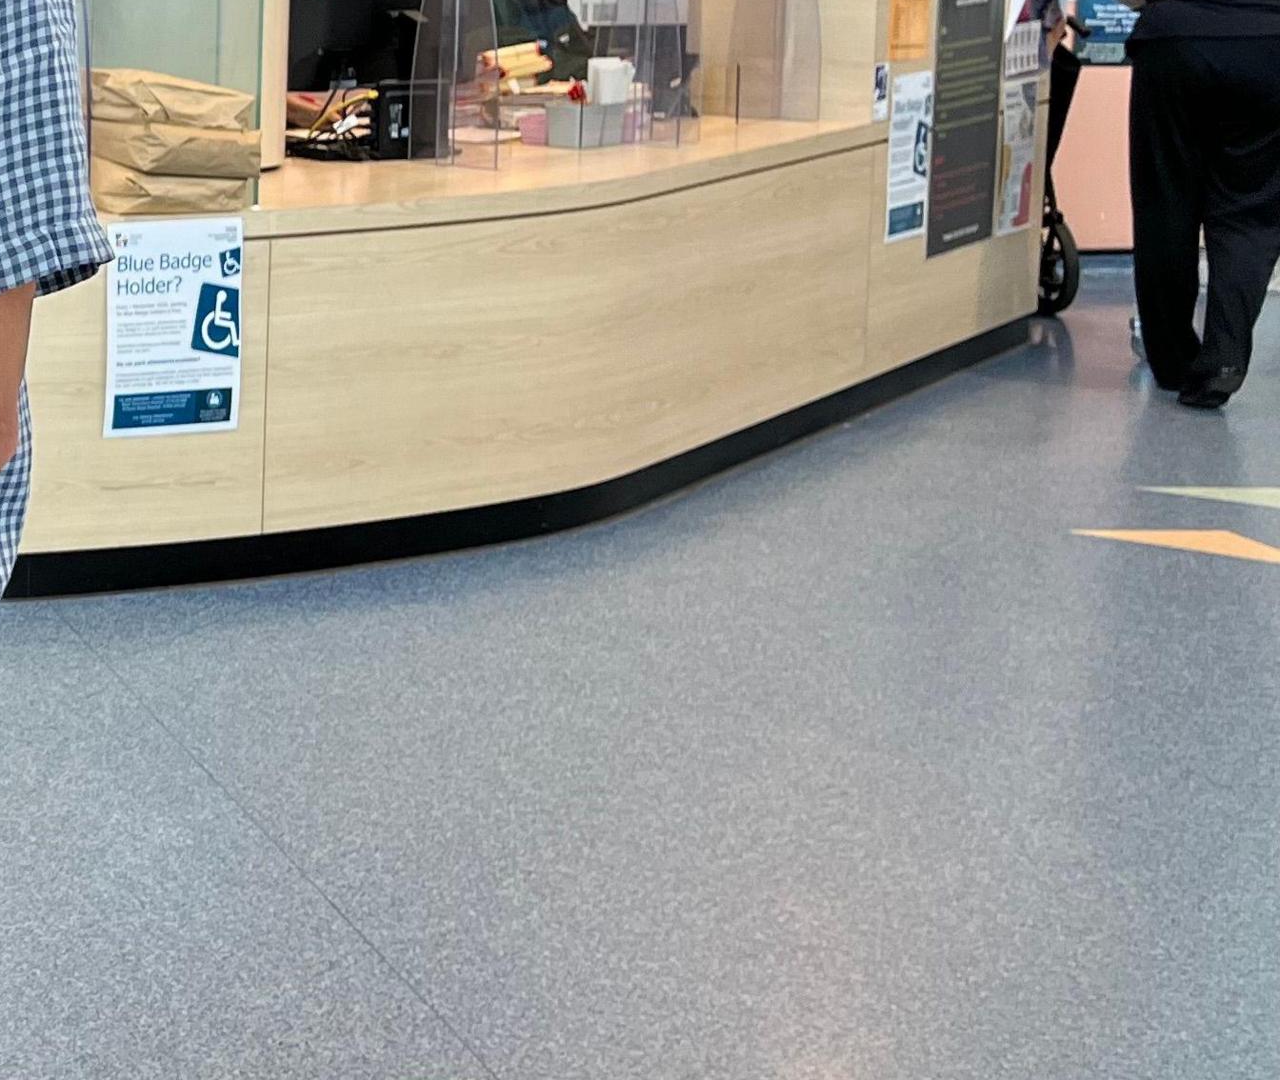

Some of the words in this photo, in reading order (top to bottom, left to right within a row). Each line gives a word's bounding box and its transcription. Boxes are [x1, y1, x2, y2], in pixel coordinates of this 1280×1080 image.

[117, 255, 154, 272] Blue
[160, 252, 212, 273] Badge
[117, 276, 182, 296] Holder?
